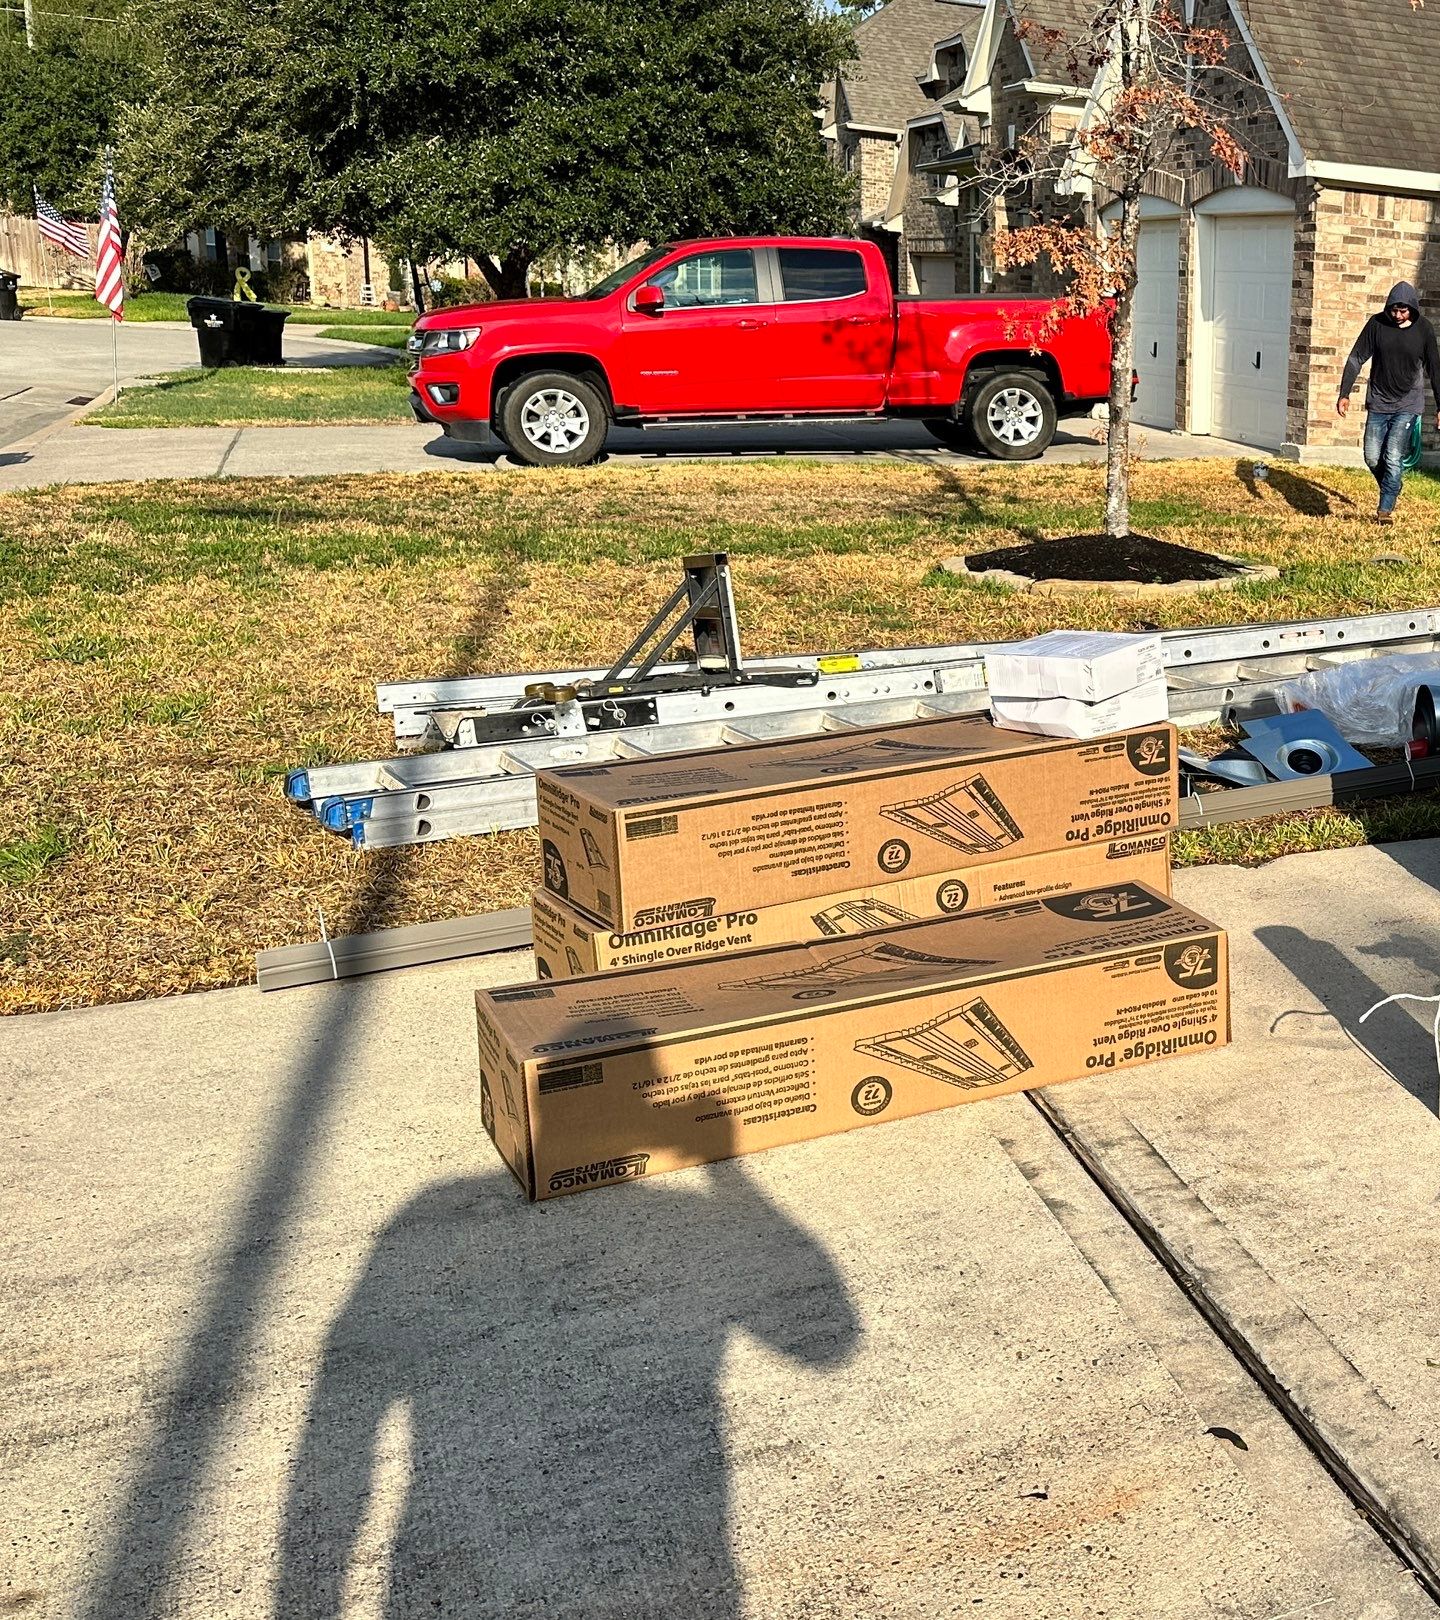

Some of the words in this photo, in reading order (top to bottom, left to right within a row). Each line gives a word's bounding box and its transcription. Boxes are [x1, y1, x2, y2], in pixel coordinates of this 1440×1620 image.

[1134, 796, 1162, 811] Shingle
[1163, 796, 1170, 805] 4'
[1090, 805, 1113, 819] Ridge
[1115, 803, 1133, 815] Over
[1071, 811, 1089, 823] Vent
[1095, 807, 1170, 838] OmniRidge
[1065, 826, 1088, 844] Pro
[1109, 836, 1166, 853] LOMANCO
[888, 849, 901, 861] 72
[994, 880, 1026, 892] Features:
[947, 893, 959, 903] 72
[634, 903, 713, 927] LOMANCO
[610, 957, 619, 967] 4'
[622, 950, 664, 966] Shingle
[666, 945, 693, 957] Over
[695, 939, 725, 954] Ridge
[727, 934, 752, 945] Vent
[1172, 1012, 1207, 1030] Shingle
[1209, 1013, 1217, 1022] 4'
[1117, 1026, 1145, 1042] Ridge
[1147, 1022, 1170, 1035] Over
[774, 1036, 807, 1050] Garantía
[1092, 1034, 1116, 1047] Vent
[1123, 1025, 1217, 1063] OmniRidge
[713, 1051, 727, 1060] por
[729, 1050, 739, 1059] de
[740, 1043, 772, 1057] limitada
[770, 1050, 788, 1061] para
[789, 1046, 807, 1058] Apto
[694, 1055, 711, 1065] vida
[729, 1053, 769, 1070] gradientes
[1085, 1051, 1115, 1071] Pro
[694, 1066, 716, 1077] techo
[718, 1063, 728, 1072] de
[662, 1073, 681, 1084] 2/12
[682, 1070, 693, 1079] de
[763, 1073, 793, 1086] orificios
[794, 1069, 809, 1080] Seis
[632, 1078, 654, 1090] 16/12
[722, 1081, 750, 1095] drenaje
[752, 1080, 762, 1088] de
[775, 1080, 809, 1095] Deflector
[686, 1093, 691, 1101] y
[693, 1091, 705, 1101] pie
[706, 1087, 720, 1097] por
[746, 1088, 774, 1100] Venturi
[784, 1091, 810, 1104] Diseño
[864, 1088, 880, 1100] 72
[652, 1099, 670, 1109] lado
[671, 1094, 685, 1105] por
[716, 1094, 745, 1107] externo
[754, 1099, 771, 1110] bajo
[773, 1098, 782, 1106] de
[733, 1103, 753, 1115] perfil
[695, 1109, 731, 1123] avanzado
[575, 1160, 613, 1174] VENTS
[549, 1162, 646, 1191] LOMANCO
